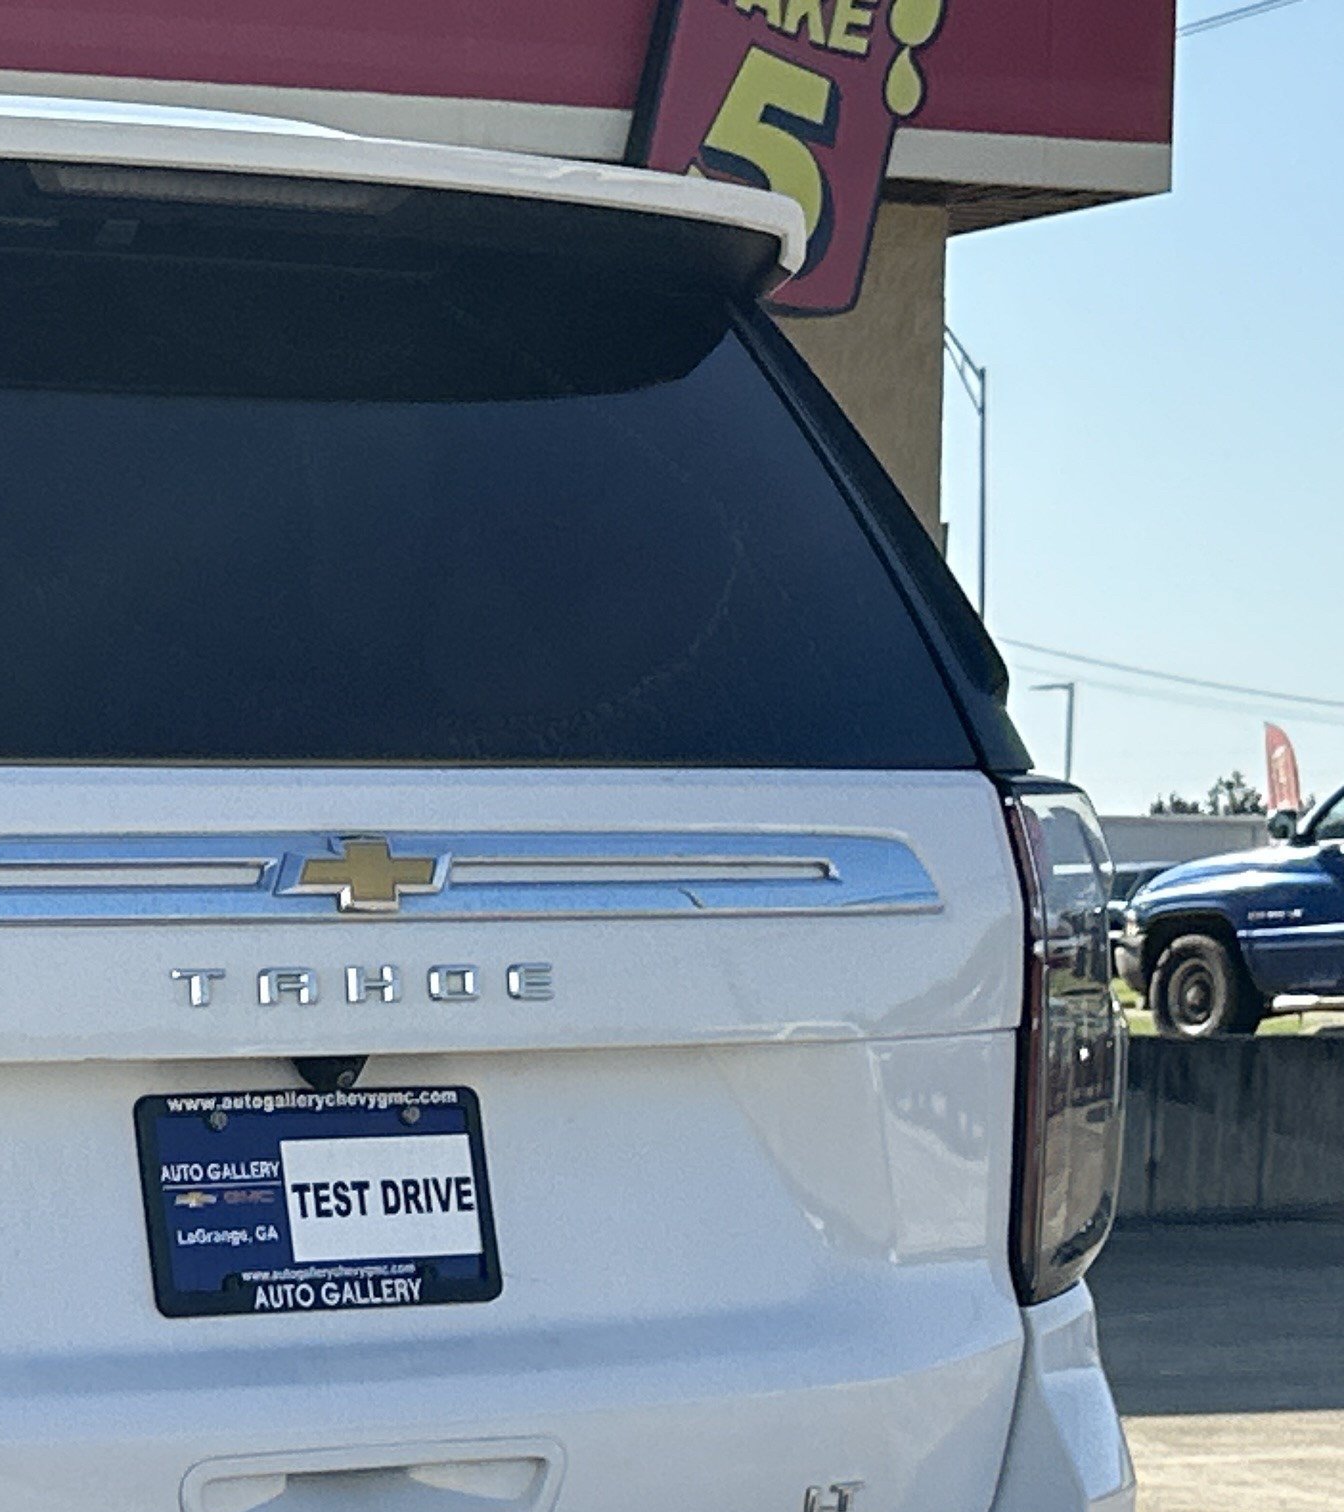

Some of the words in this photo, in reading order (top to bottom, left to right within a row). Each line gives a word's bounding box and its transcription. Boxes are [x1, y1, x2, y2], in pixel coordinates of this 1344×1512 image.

[170, 963, 555, 1007] TAHOE
[166, 1089, 459, 1113] www.autogallerychevygmc.com
[161, 1163, 204, 1182] AUTO
[206, 1160, 280, 1180] GALLERY
[291, 1180, 370, 1219] TEST
[381, 1176, 476, 1215] DRIVE
[254, 1224, 280, 1242] GA
[254, 1283, 315, 1311] AUTO
[320, 1277, 422, 1306] GALLERY
